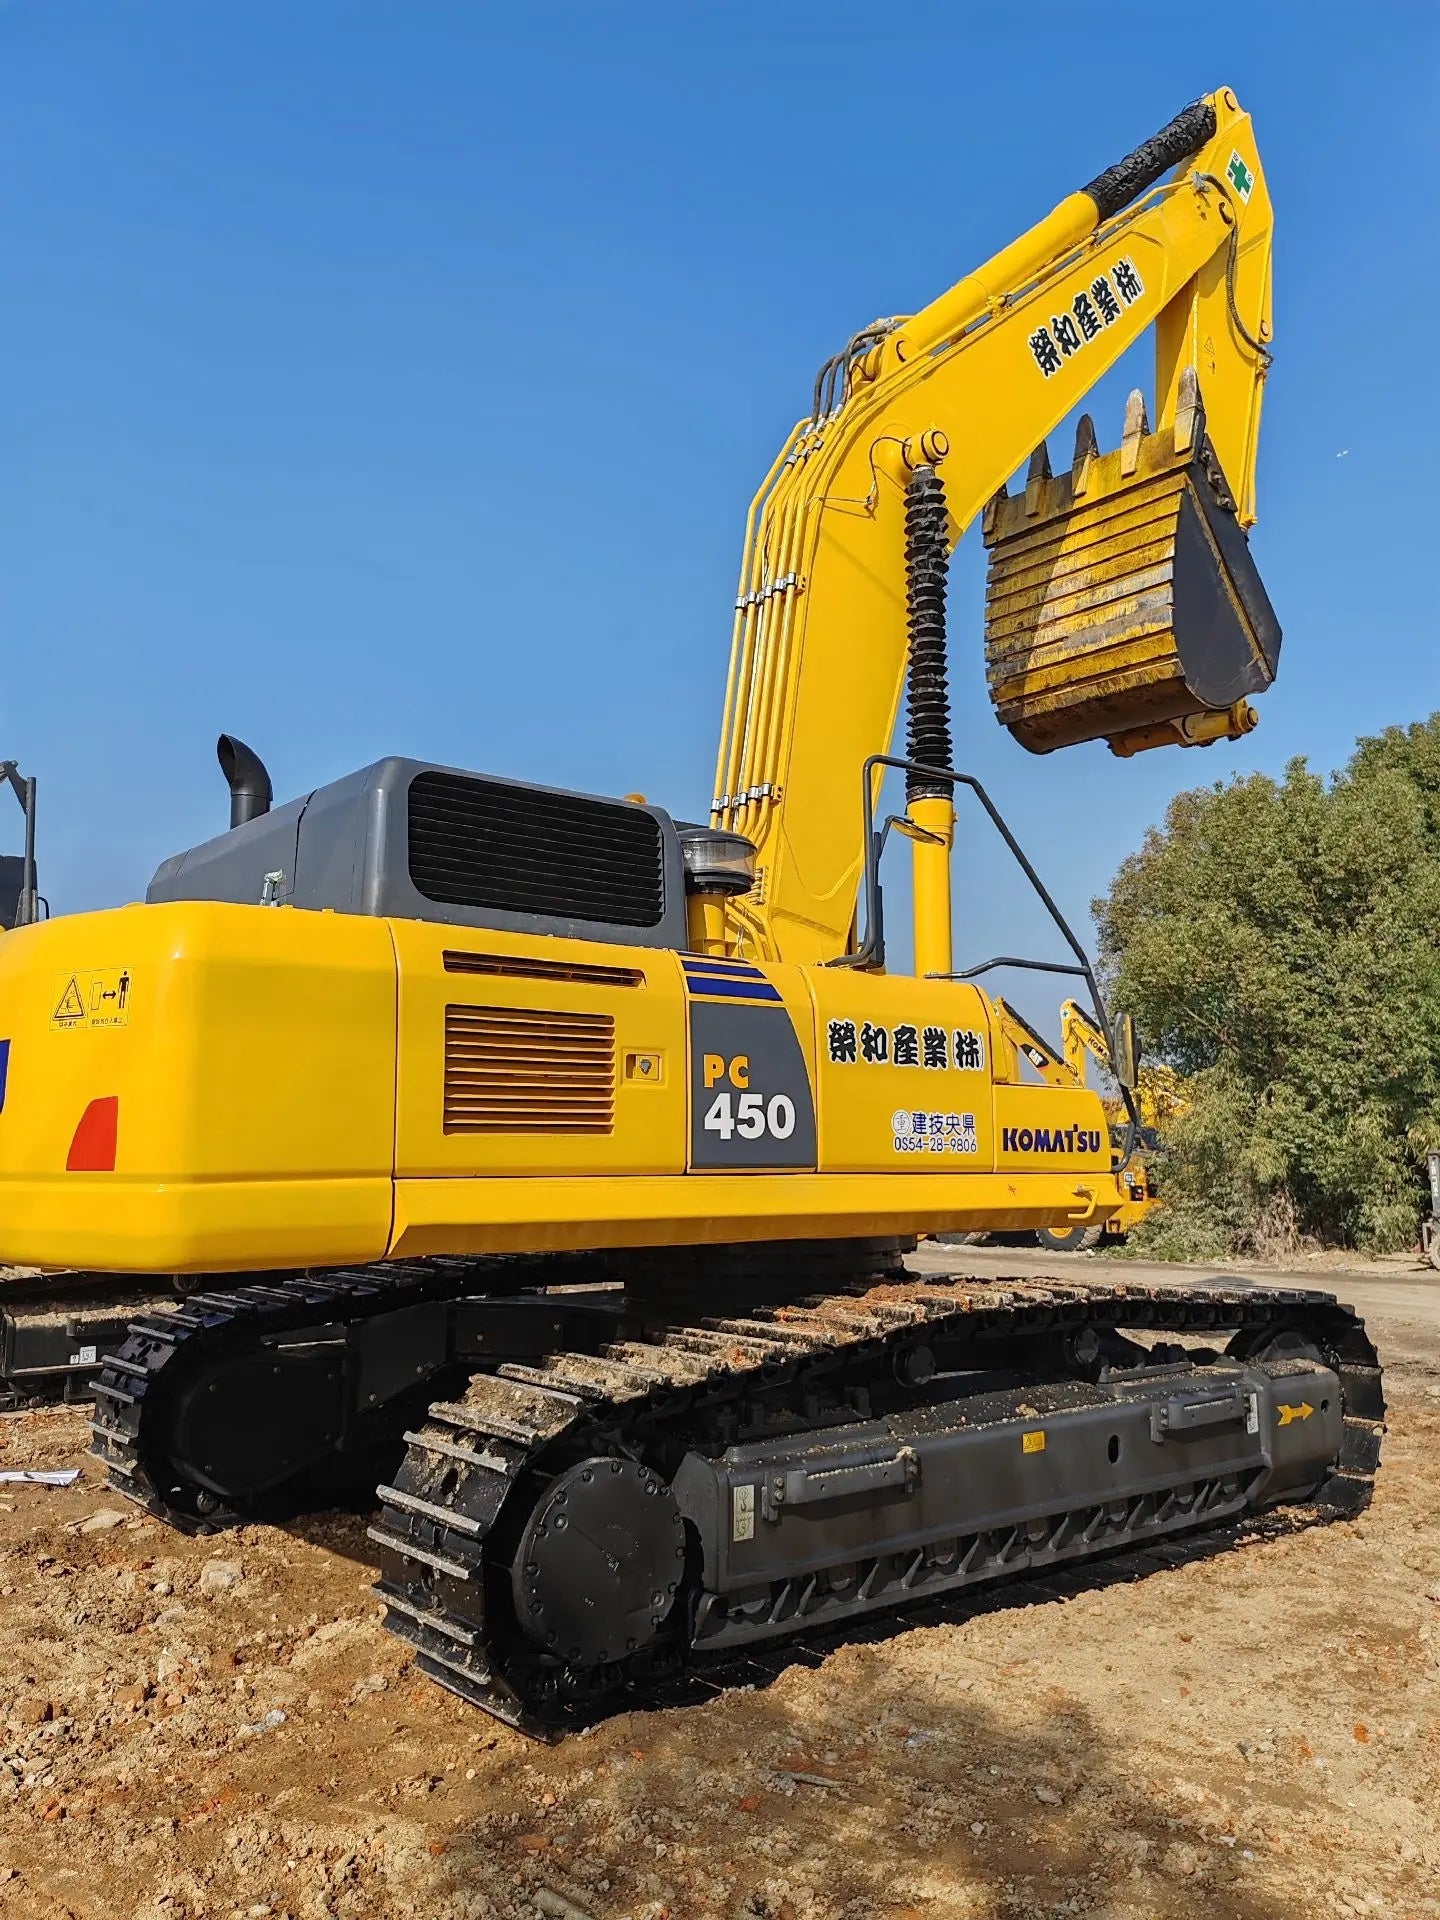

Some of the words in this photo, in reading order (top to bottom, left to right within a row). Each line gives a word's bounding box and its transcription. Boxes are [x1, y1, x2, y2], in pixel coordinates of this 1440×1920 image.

[703, 1054, 749, 1089] PC
[704, 1092, 796, 1140] 450
[1002, 1123, 1101, 1153] KOMATSU
